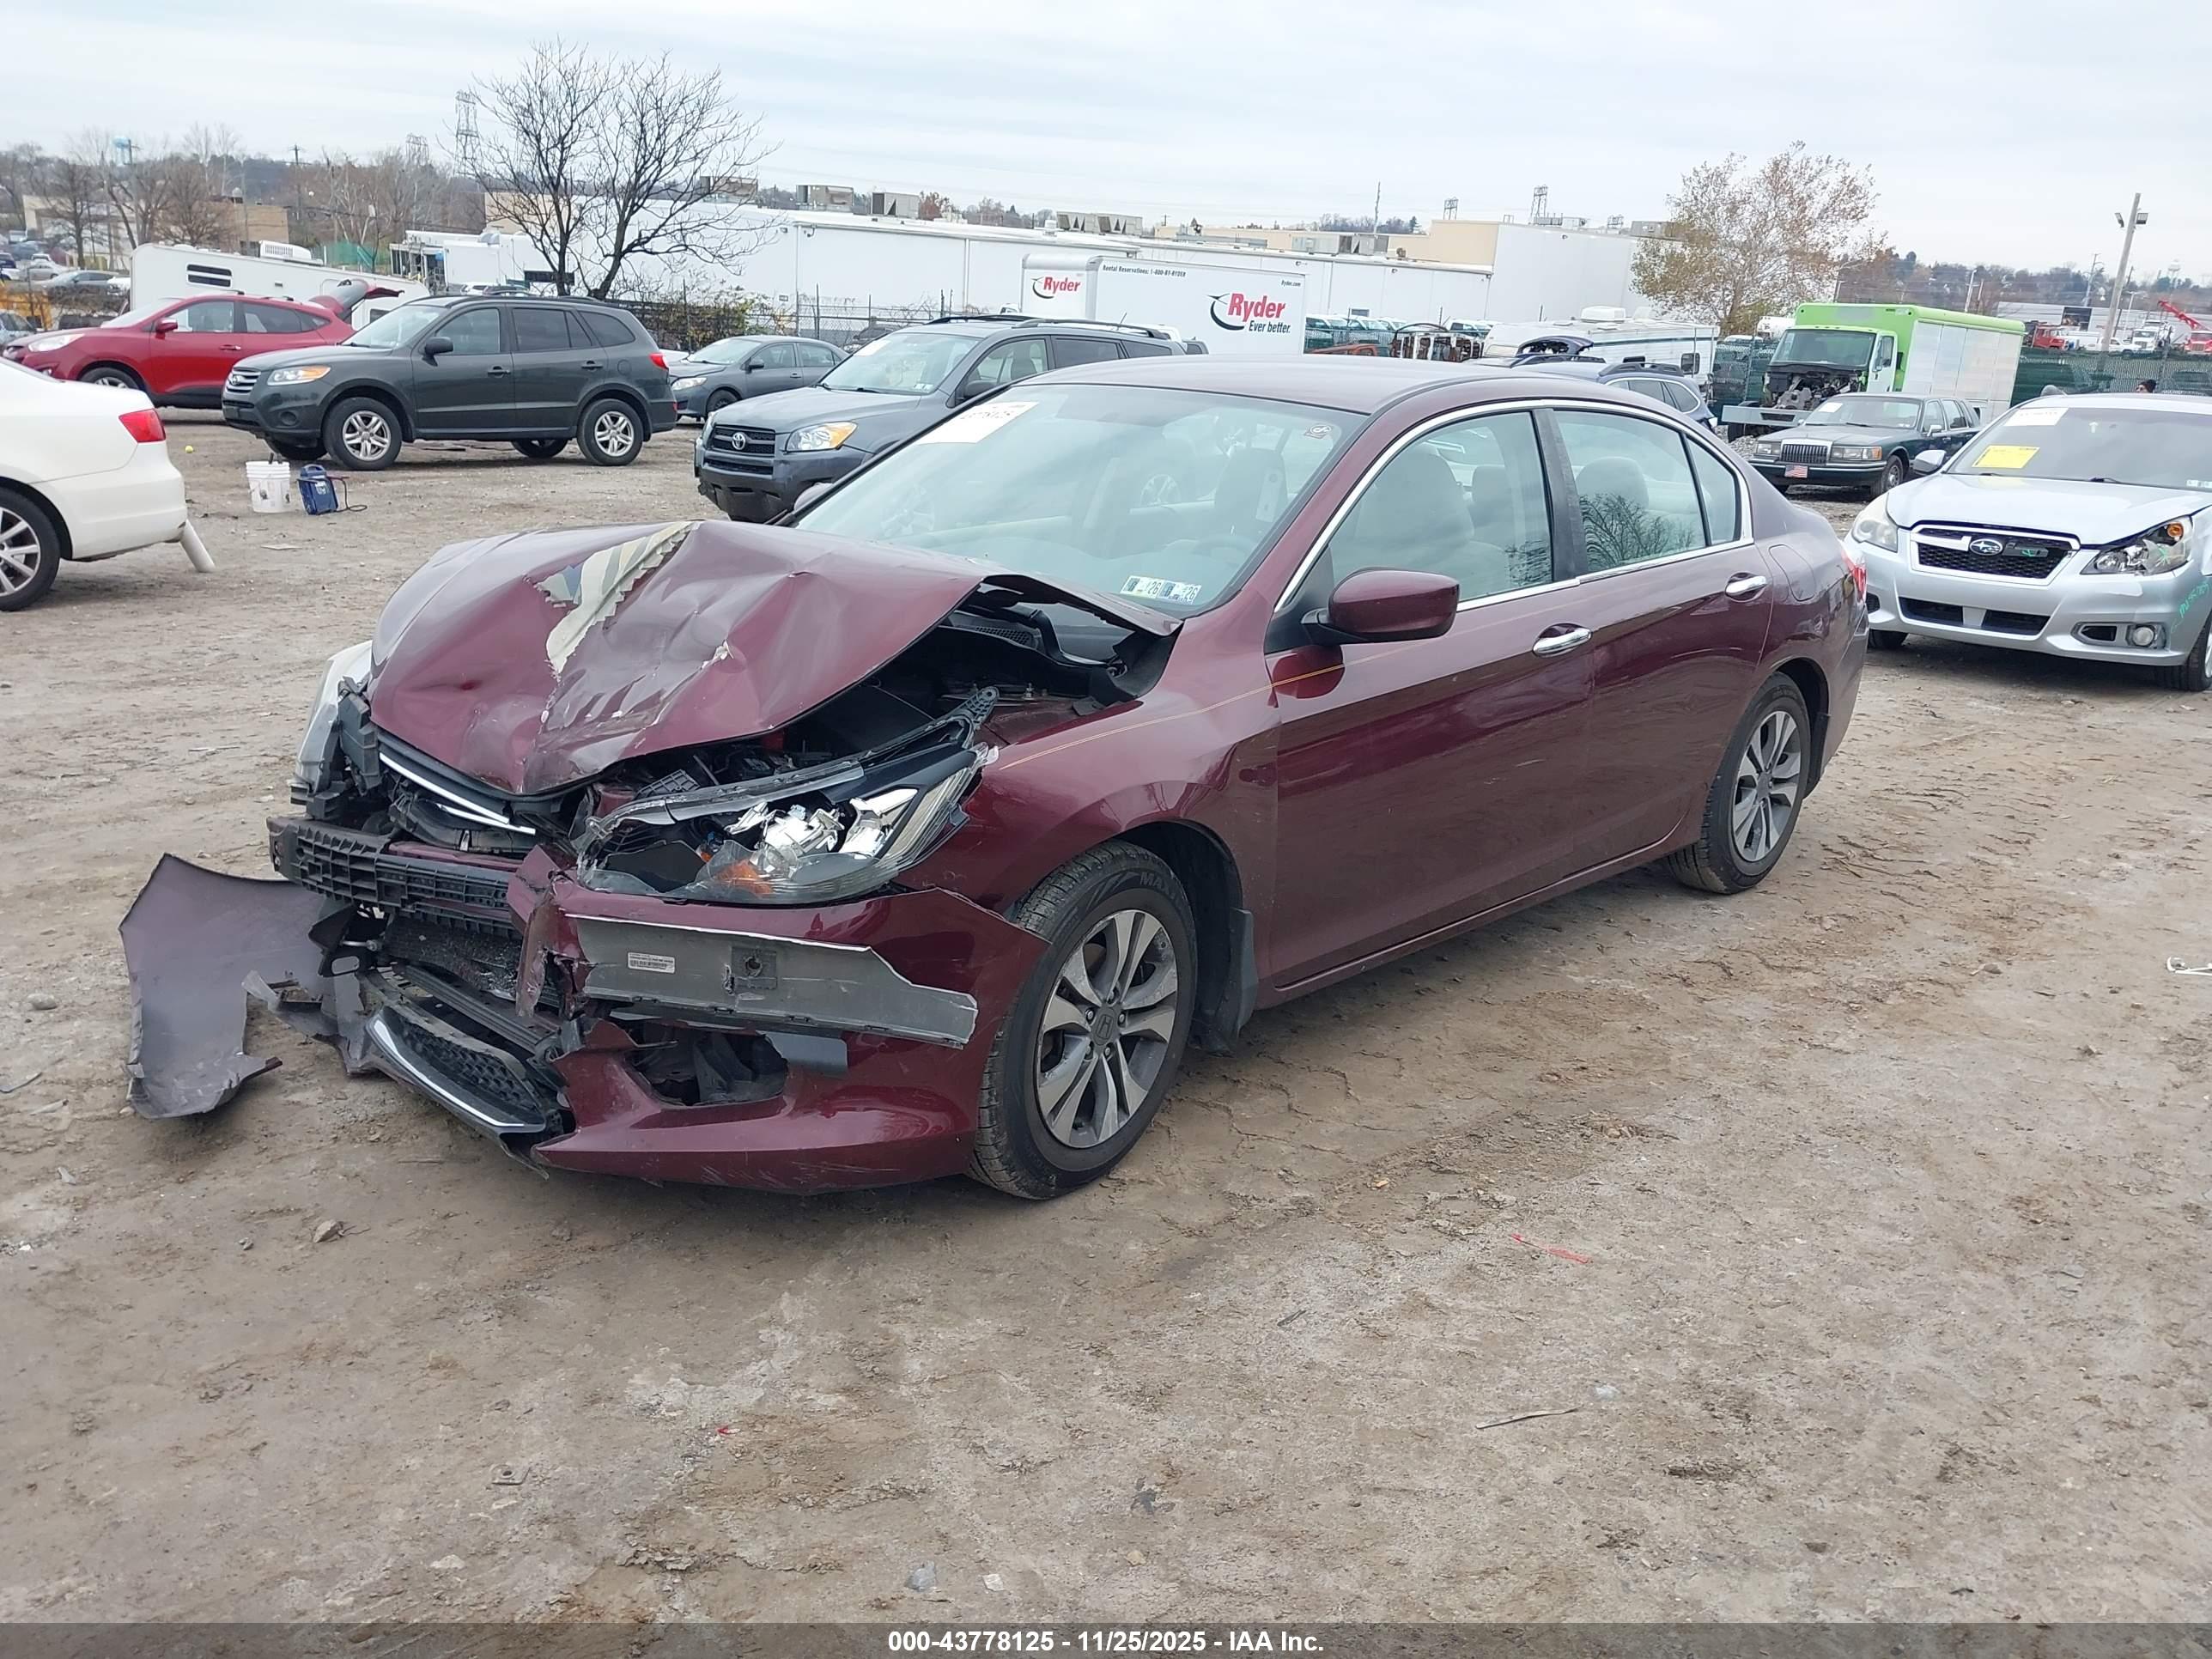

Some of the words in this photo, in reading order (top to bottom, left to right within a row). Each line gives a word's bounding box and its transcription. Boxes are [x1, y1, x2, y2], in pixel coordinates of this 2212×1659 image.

[1043, 276, 1081, 294] Ryder
[1228, 293, 1285, 322] Ryder
[1249, 319, 1266, 332] Ever
[1267, 322, 1291, 333] better.
